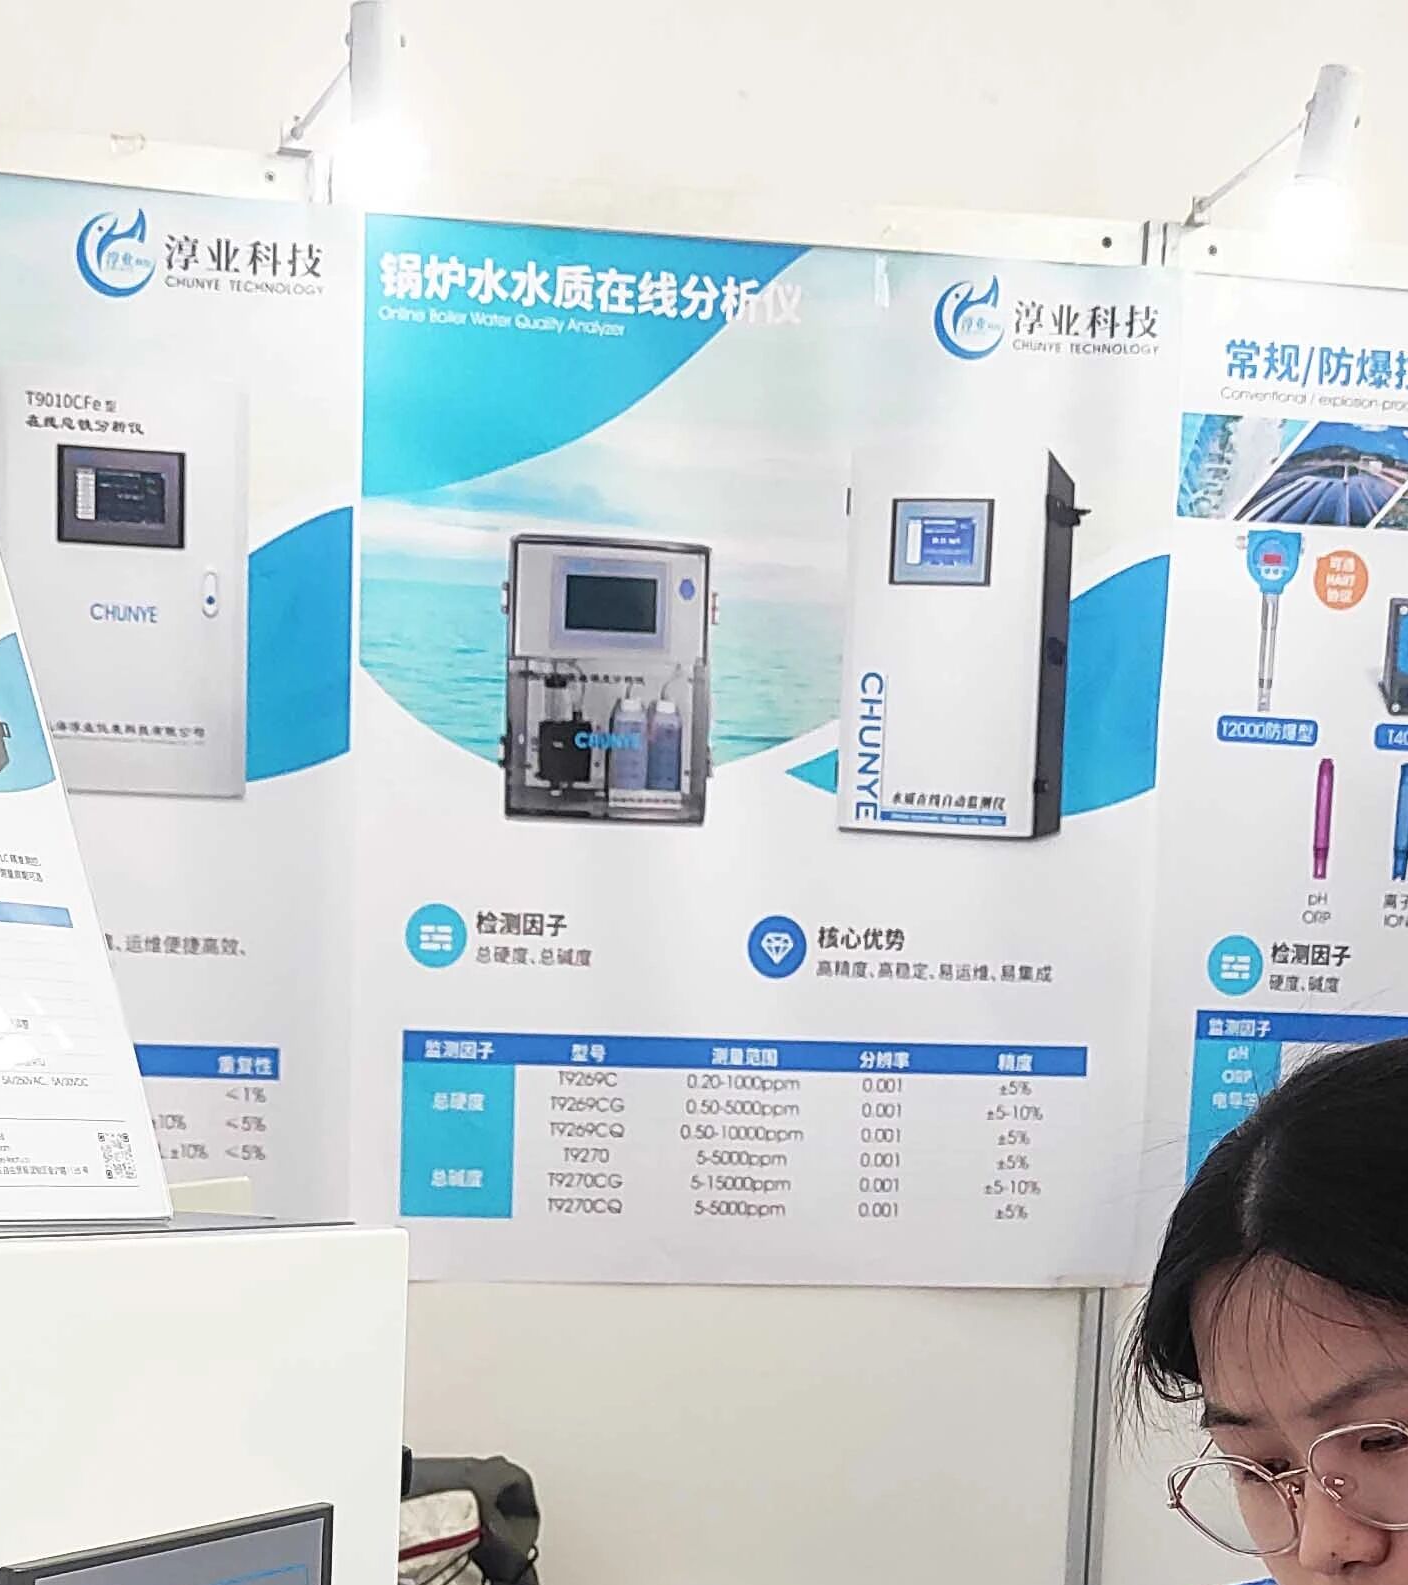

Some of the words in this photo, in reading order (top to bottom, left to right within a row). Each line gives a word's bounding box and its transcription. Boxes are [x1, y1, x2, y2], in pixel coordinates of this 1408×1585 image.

[164, 234, 323, 279] 淳业科技
[164, 275, 221, 292] CHUNYE
[229, 278, 325, 297] TECHNOLOGY
[378, 251, 802, 326] 锅炉水水质在线分析仪
[471, 311, 512, 329] Water
[515, 314, 564, 334] Quality
[1013, 300, 1159, 340] 淳业科技
[1012, 338, 1063, 353] CHUNYE
[1070, 341, 1160, 357] TECHNOLOGY
[90, 603, 159, 624] CHUNYE
[855, 671, 884, 821] CHUNYE
[476, 911, 568, 938] 检测因子
[818, 926, 905, 952] 核心优势
[475, 945, 592, 967] 总硬度、总碱度
[1271, 942, 1351, 967] 检测因子
[424, 1038, 495, 1060] 监测因子
[569, 1043, 607, 1063] 型号
[711, 1047, 779, 1067] 测量范围
[858, 1050, 911, 1069] 分辨率
[997, 1052, 1033, 1072] 精度
[557, 1069, 618, 1088] T9269C
[686, 1072, 801, 1092] 0.20-1000ppm
[861, 1077, 903, 1094] 0.001
[550, 1096, 625, 1113] T9269CG
[685, 1098, 800, 1118] 0.50-5000ppm
[861, 1102, 902, 1119] 0.001
[550, 1121, 626, 1139] T9269CQ
[680, 1123, 804, 1143] 0.50-10000ppm
[860, 1127, 901, 1144] 0.001
[563, 1147, 610, 1164] T9270
[696, 1149, 788, 1168] 5-5000ppm
[859, 1152, 901, 1168] 0.001
[547, 1172, 623, 1189] T9270CG
[690, 1174, 791, 1194] 5-15000ppm
[858, 1177, 900, 1193] 0.001
[547, 1197, 624, 1215] T9270CQ
[693, 1199, 786, 1219] 5-5000ppm
[857, 1202, 899, 1218] 0.001
